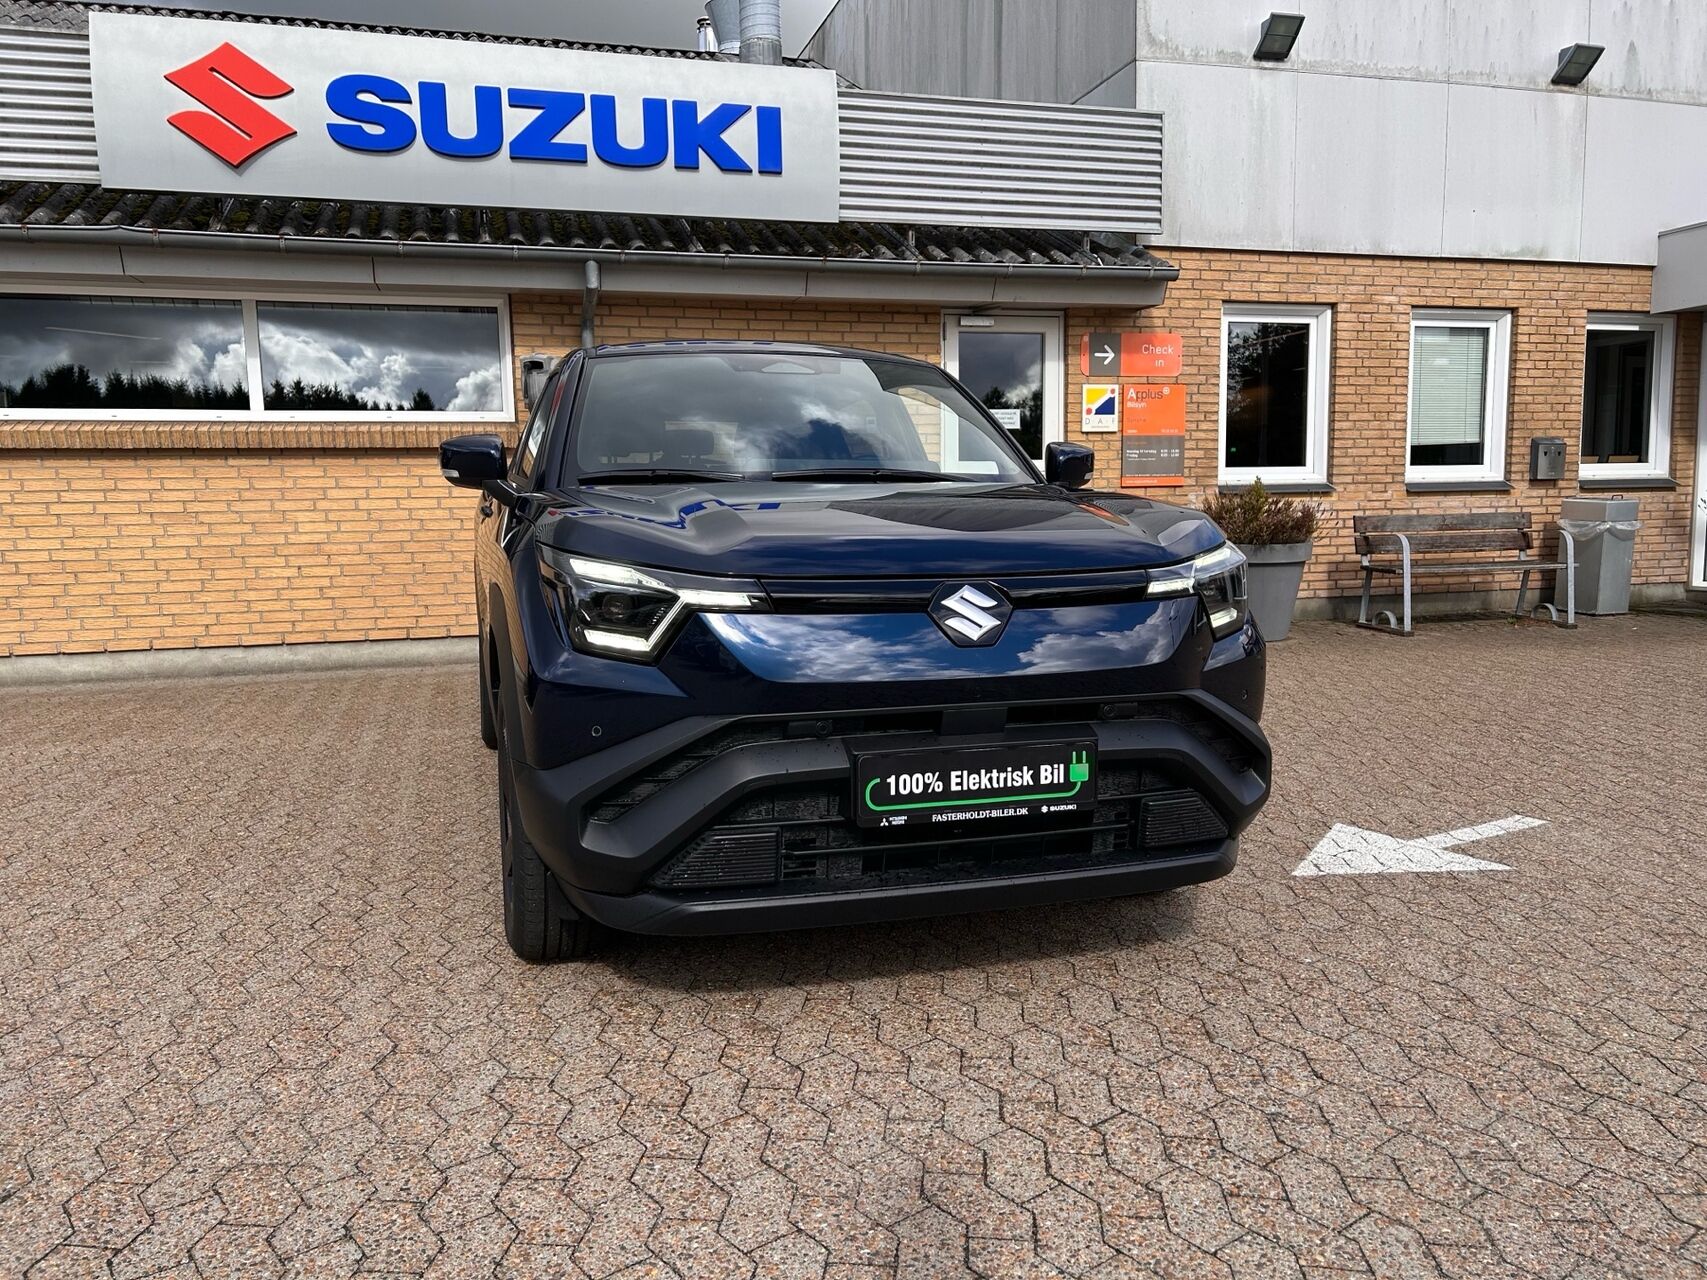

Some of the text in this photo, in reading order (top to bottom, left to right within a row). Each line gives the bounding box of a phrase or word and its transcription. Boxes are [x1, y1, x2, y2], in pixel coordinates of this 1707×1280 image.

[325, 73, 784, 175] SUZUKI
[1142, 344, 1174, 355] Check
[1155, 359, 1165, 367] in
[1127, 387, 1164, 402] Applus
[886, 763, 1065, 796] 100% Elektrisk Bil
[931, 806, 1029, 822] FASTERHOLDT-BILER.DK
[1049, 804, 1078, 812] SUZUKI
